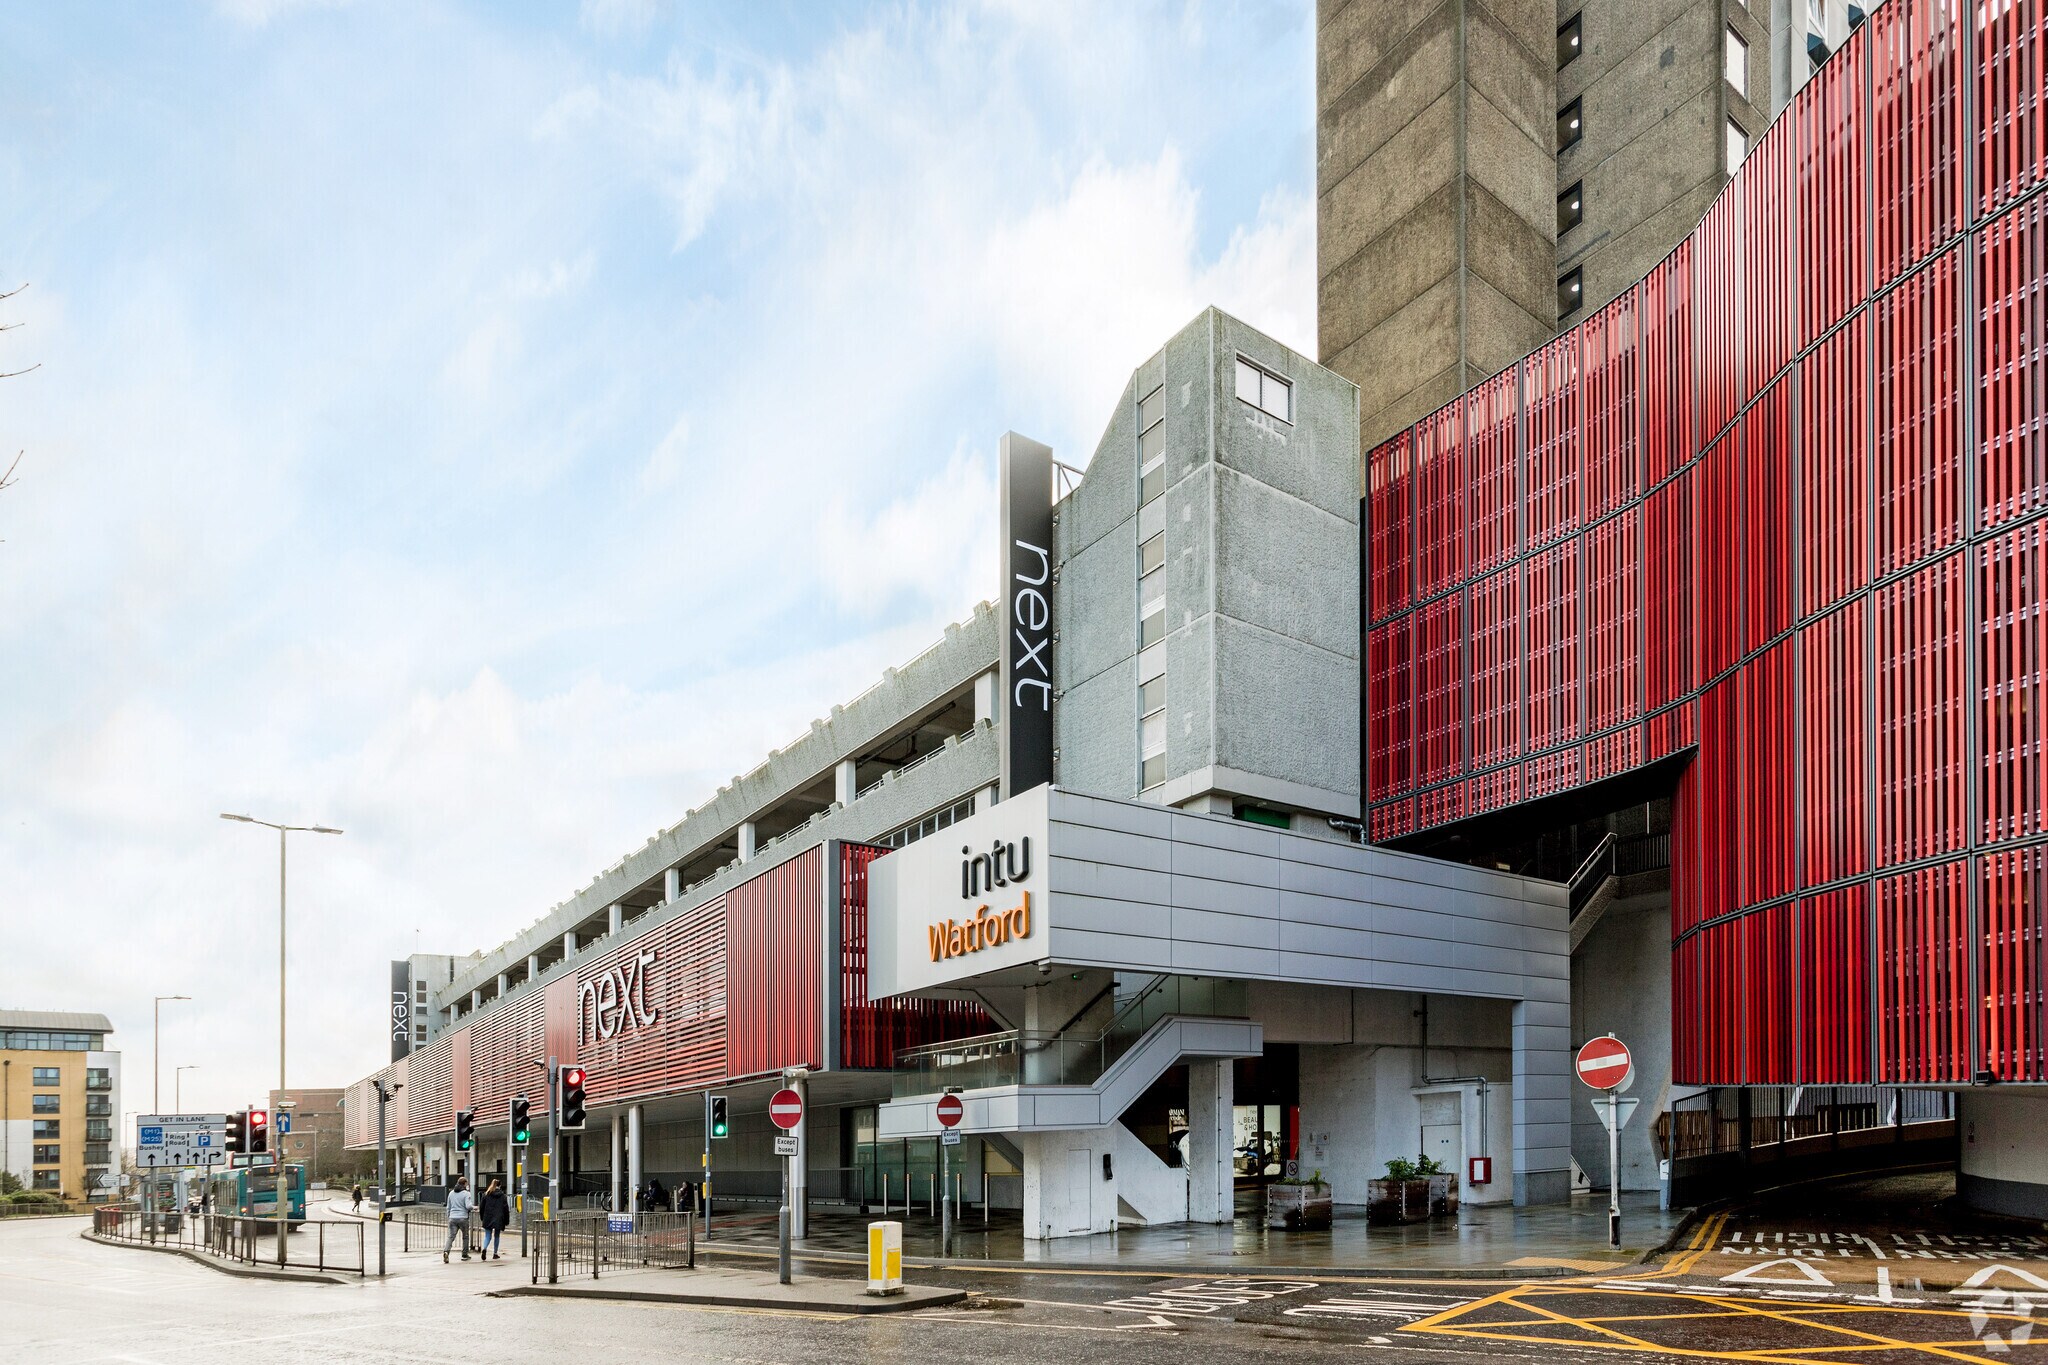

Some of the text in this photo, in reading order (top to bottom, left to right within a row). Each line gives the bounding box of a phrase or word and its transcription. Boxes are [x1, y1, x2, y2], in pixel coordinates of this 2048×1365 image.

[1015, 539, 1052, 711] next
[961, 835, 1030, 899] intu
[928, 890, 1030, 963] Watford
[393, 991, 408, 1041] next
[579, 949, 659, 1045] next
[1720, 1246, 1864, 1258] TURN
[1722, 1232, 1864, 1246] RIGHT
[1104, 1279, 1319, 1313] BUSES
[1282, 1289, 1483, 1322] ONLY
